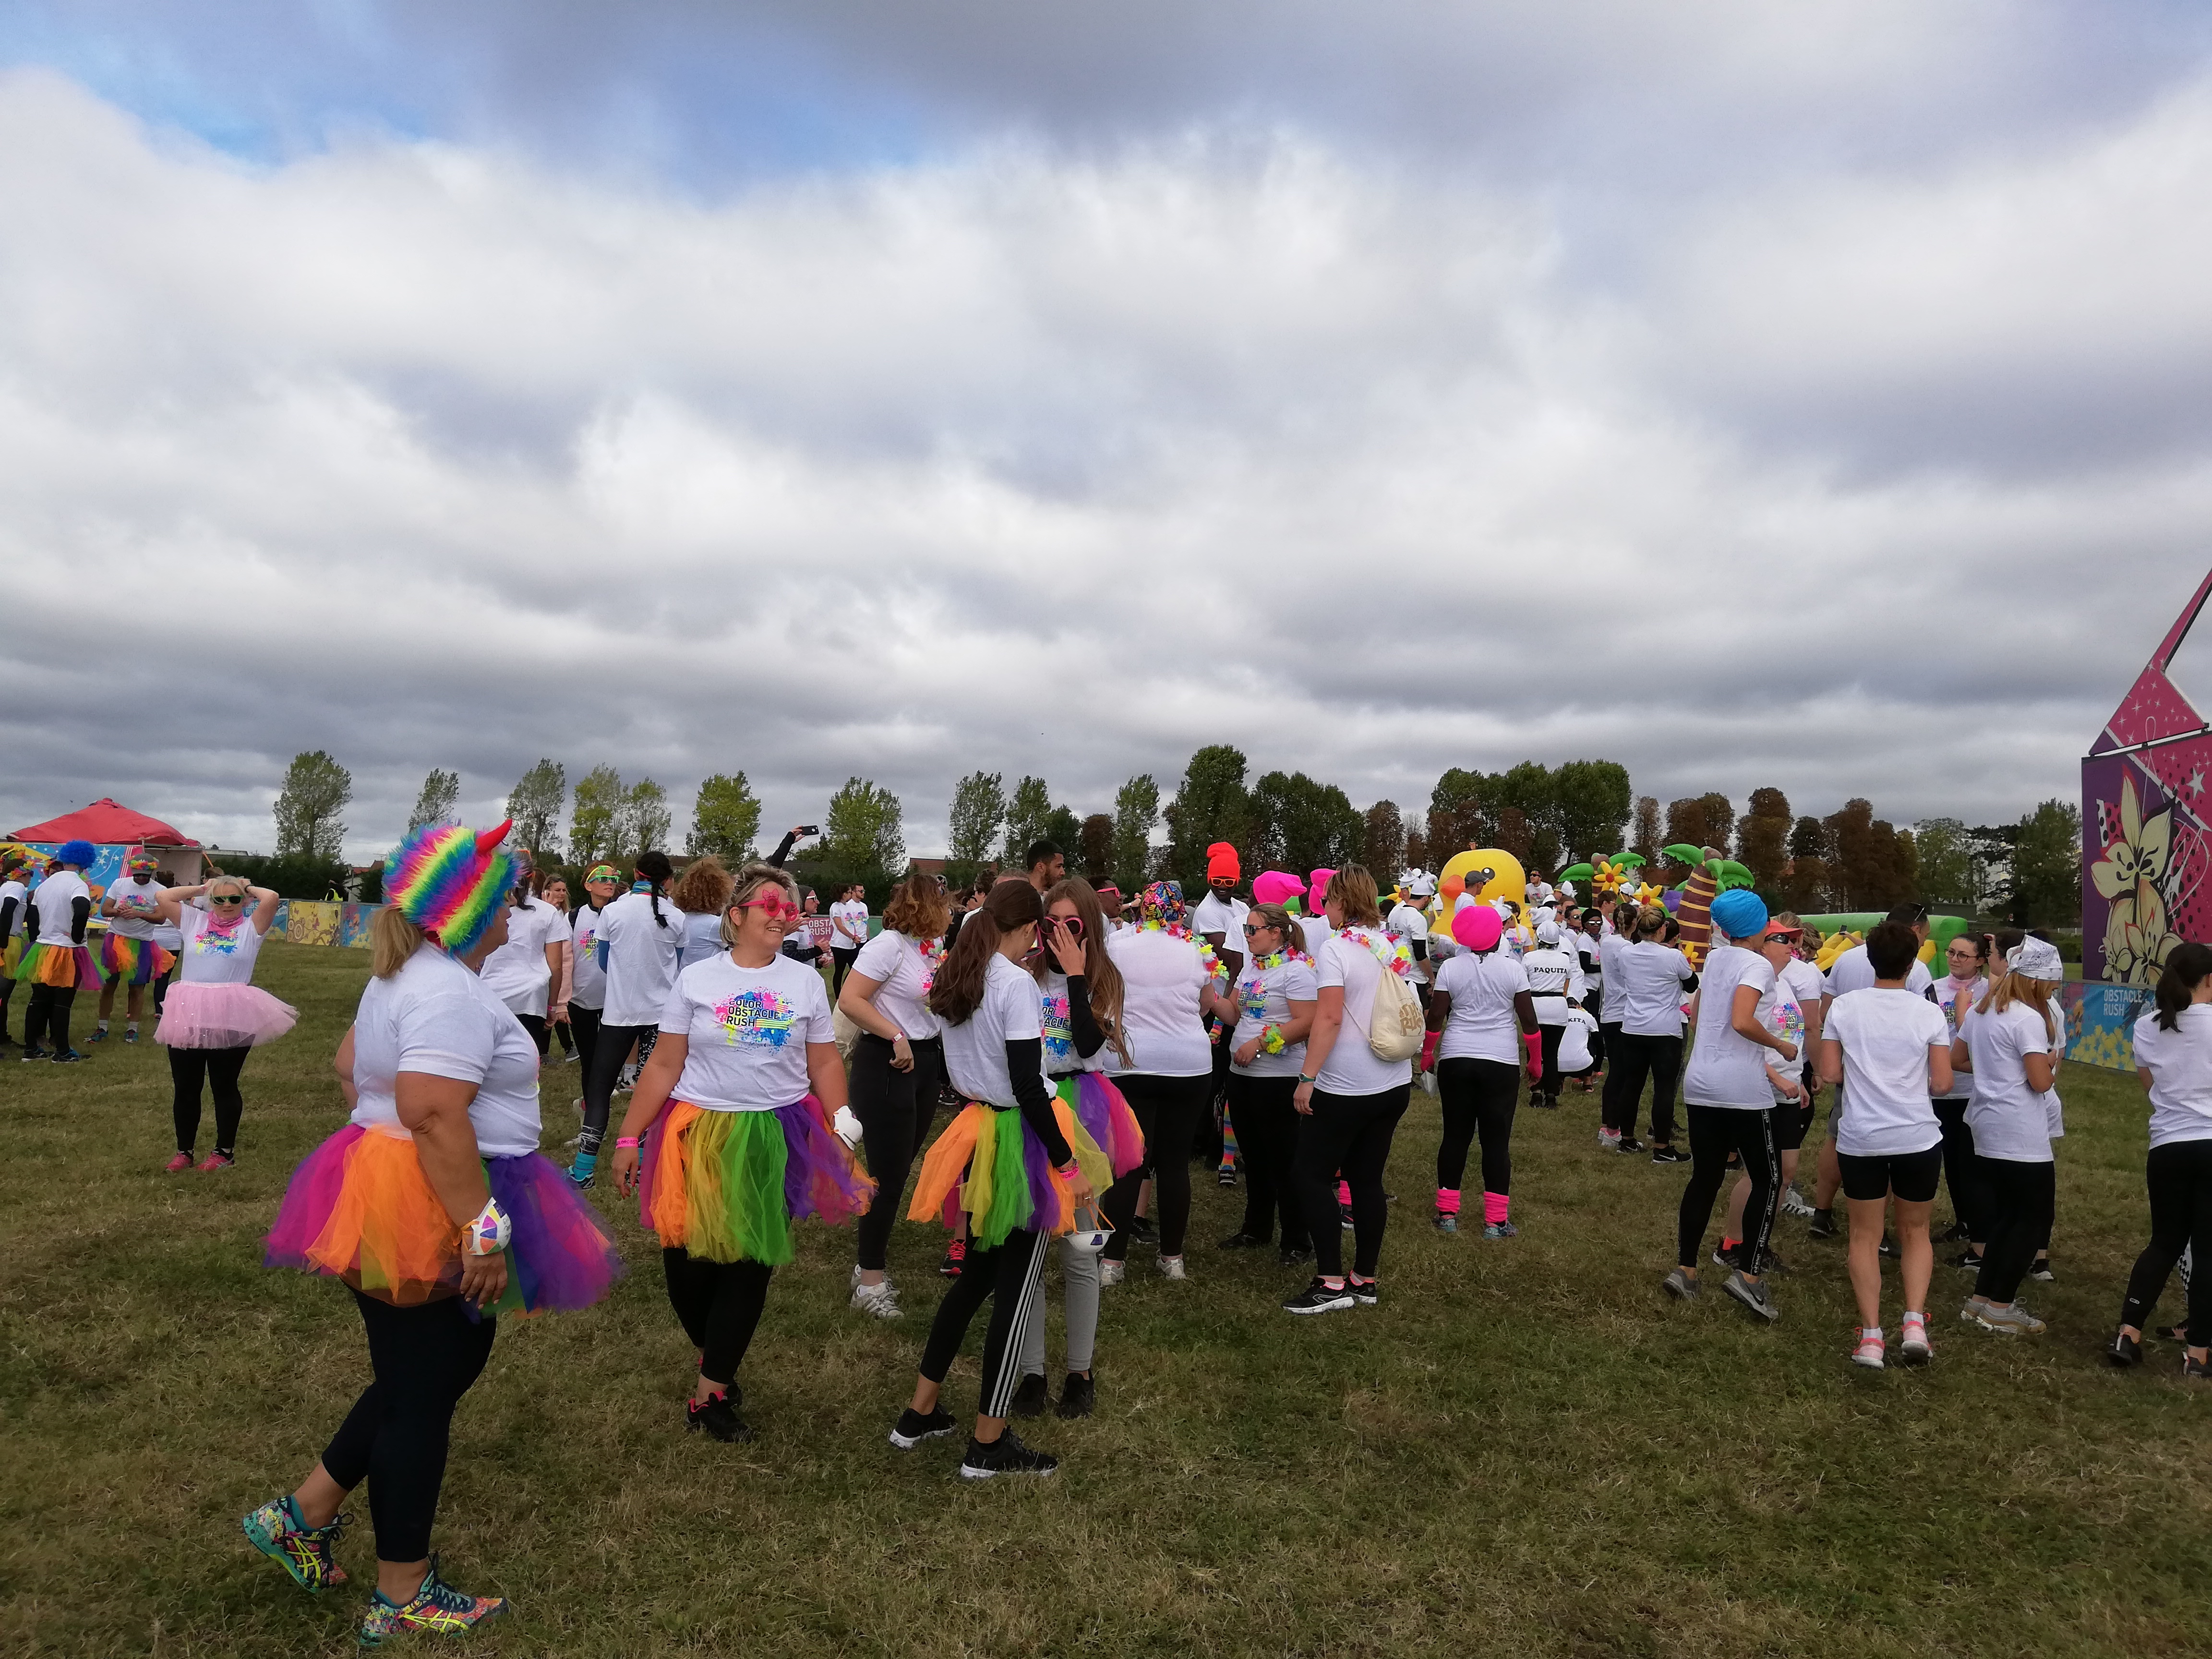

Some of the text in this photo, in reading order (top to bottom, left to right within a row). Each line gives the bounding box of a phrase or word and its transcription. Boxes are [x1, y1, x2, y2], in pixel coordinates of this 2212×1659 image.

[810, 927, 831, 936] RUSH
[2104, 989, 2143, 1003] OBSTACLE
[729, 999, 762, 1009] COLOR
[2104, 1003, 2125, 1016] RUSH
[728, 1006, 781, 1020] OBSTACLE
[726, 1015, 756, 1027] RUSH
